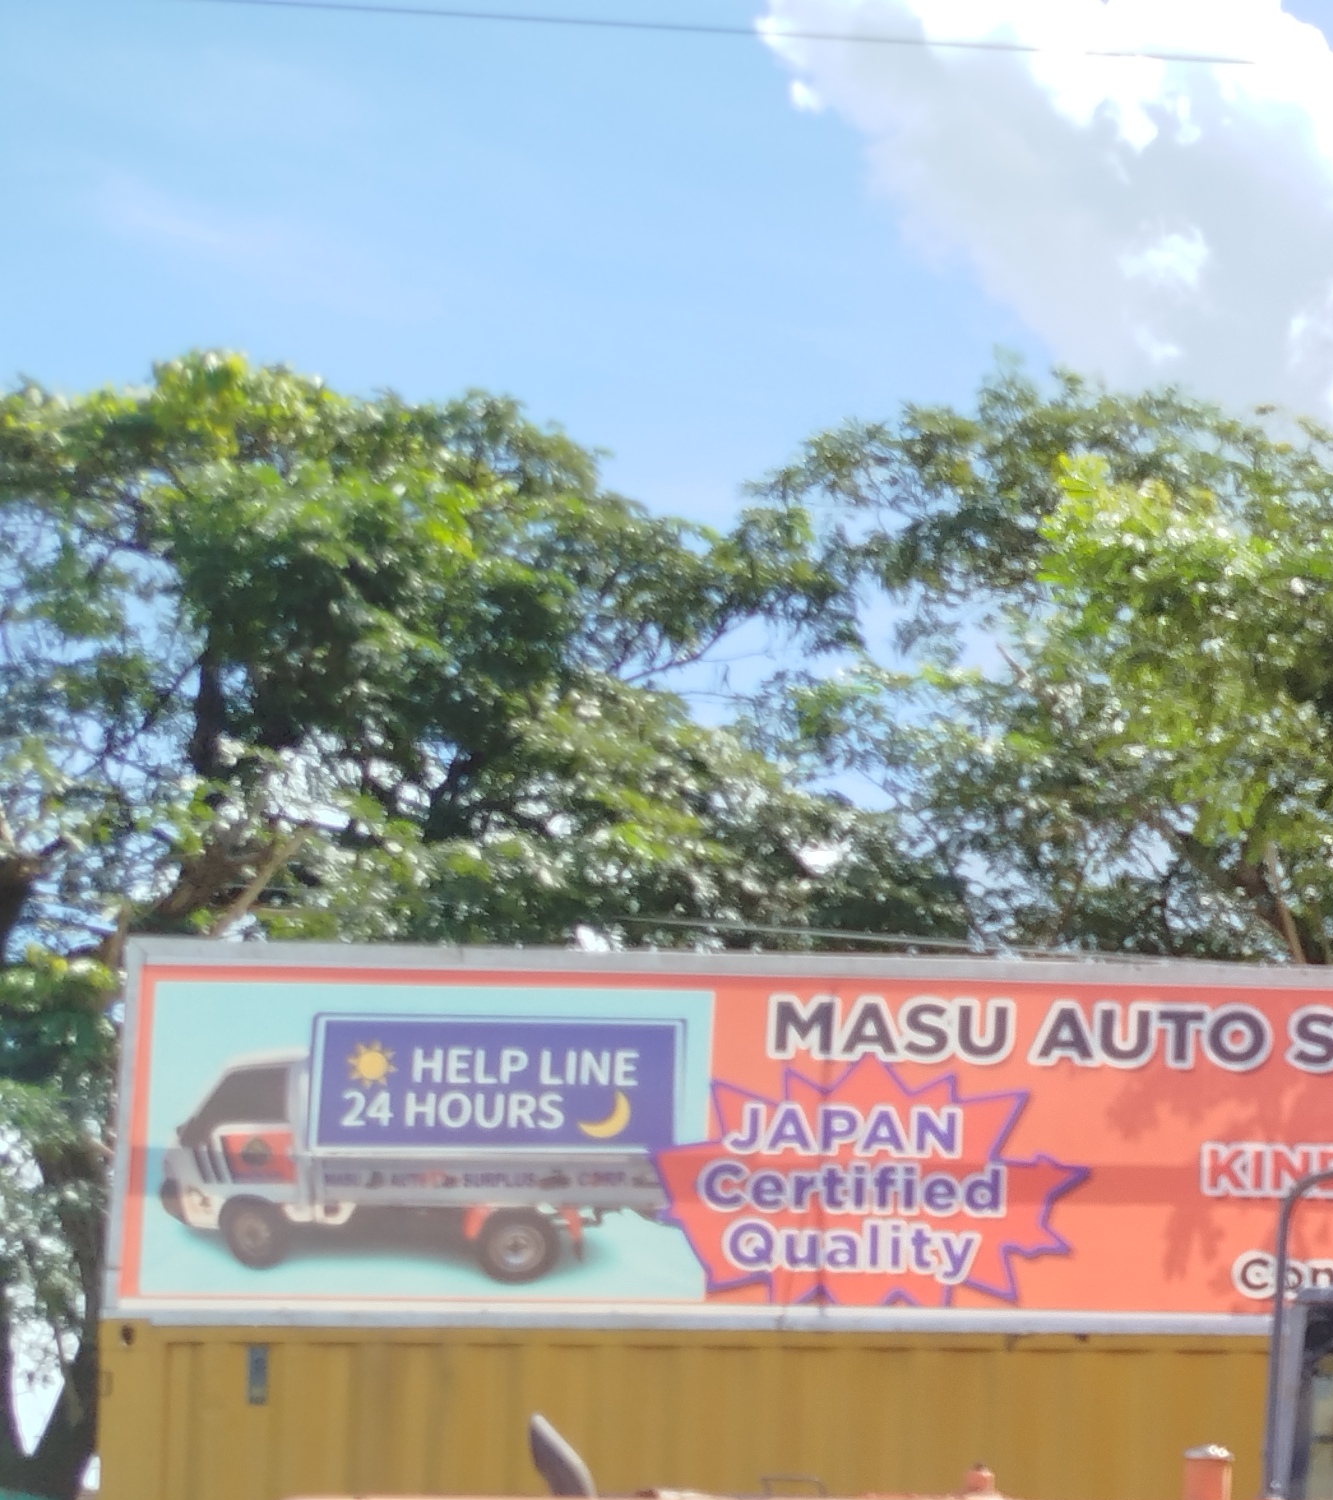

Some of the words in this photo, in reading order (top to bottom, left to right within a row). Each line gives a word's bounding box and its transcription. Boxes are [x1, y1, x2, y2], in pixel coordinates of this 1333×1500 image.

[773, 999, 1009, 1058] MASU
[1038, 1006, 1265, 1066] AUTO
[411, 1047, 529, 1086] HELP
[539, 1049, 640, 1087] LINE
[341, 1090, 394, 1128] 24
[404, 1091, 565, 1130] HOURS
[729, 1105, 959, 1155] JAPAN
[703, 1161, 1000, 1211] Certified
[728, 1221, 975, 1278] Quality
